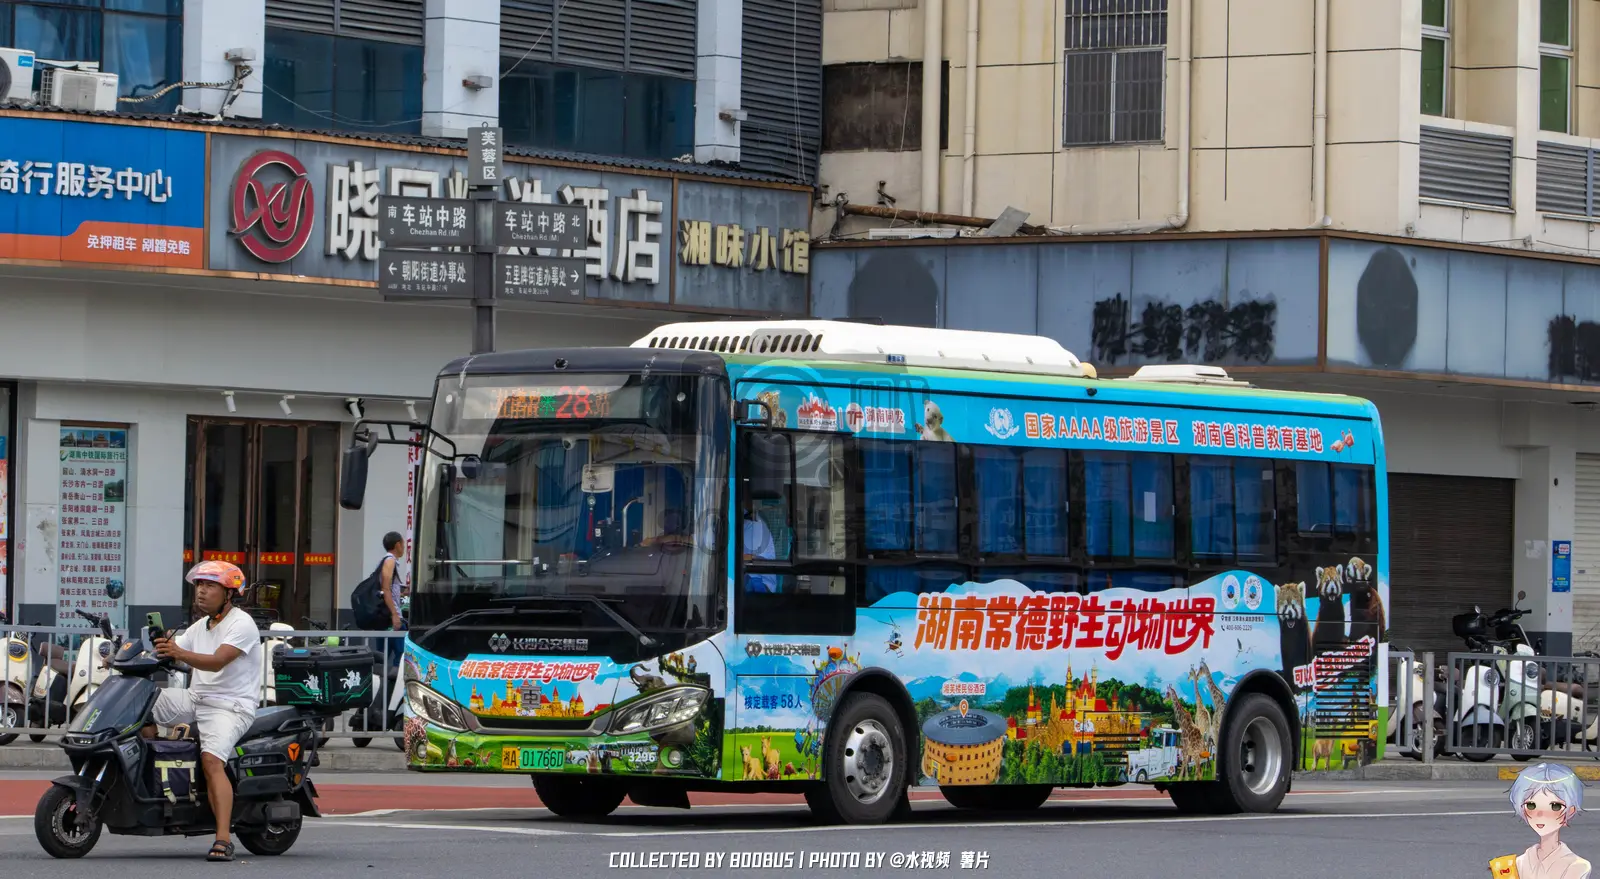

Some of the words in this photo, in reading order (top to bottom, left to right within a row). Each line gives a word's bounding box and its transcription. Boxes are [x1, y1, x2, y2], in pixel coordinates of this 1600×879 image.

[481, 130, 496, 180] 芙蓉区
[388, 205, 397, 219] 南
[402, 204, 467, 230] 车站中路
[505, 209, 566, 234] 车站中路
[572, 215, 580, 228] 北
[88, 234, 137, 251] 免押租车
[410, 228, 438, 236] Chezhan
[512, 232, 538, 240] Chezhan
[680, 220, 809, 274] 湘味小馆
[402, 260, 466, 284] 朝阳街道办事处
[505, 264, 566, 288] 五里牌街道办事处
[556, 386, 590, 418] 28
[1025, 412, 1178, 444] 国家AAAA级旅游景区
[1194, 421, 1322, 452] 湖南省科普教育基地
[914, 596, 1215, 660] 湖南常德野生动物世界
[512, 638, 588, 650] 长沙公交集团
[458, 660, 600, 684] 湖南常德野生动物世界
[744, 694, 778, 710] 核定载客
[780, 694, 802, 709] 58人
[522, 750, 564, 766] 01766D
[628, 752, 657, 762] 3296
